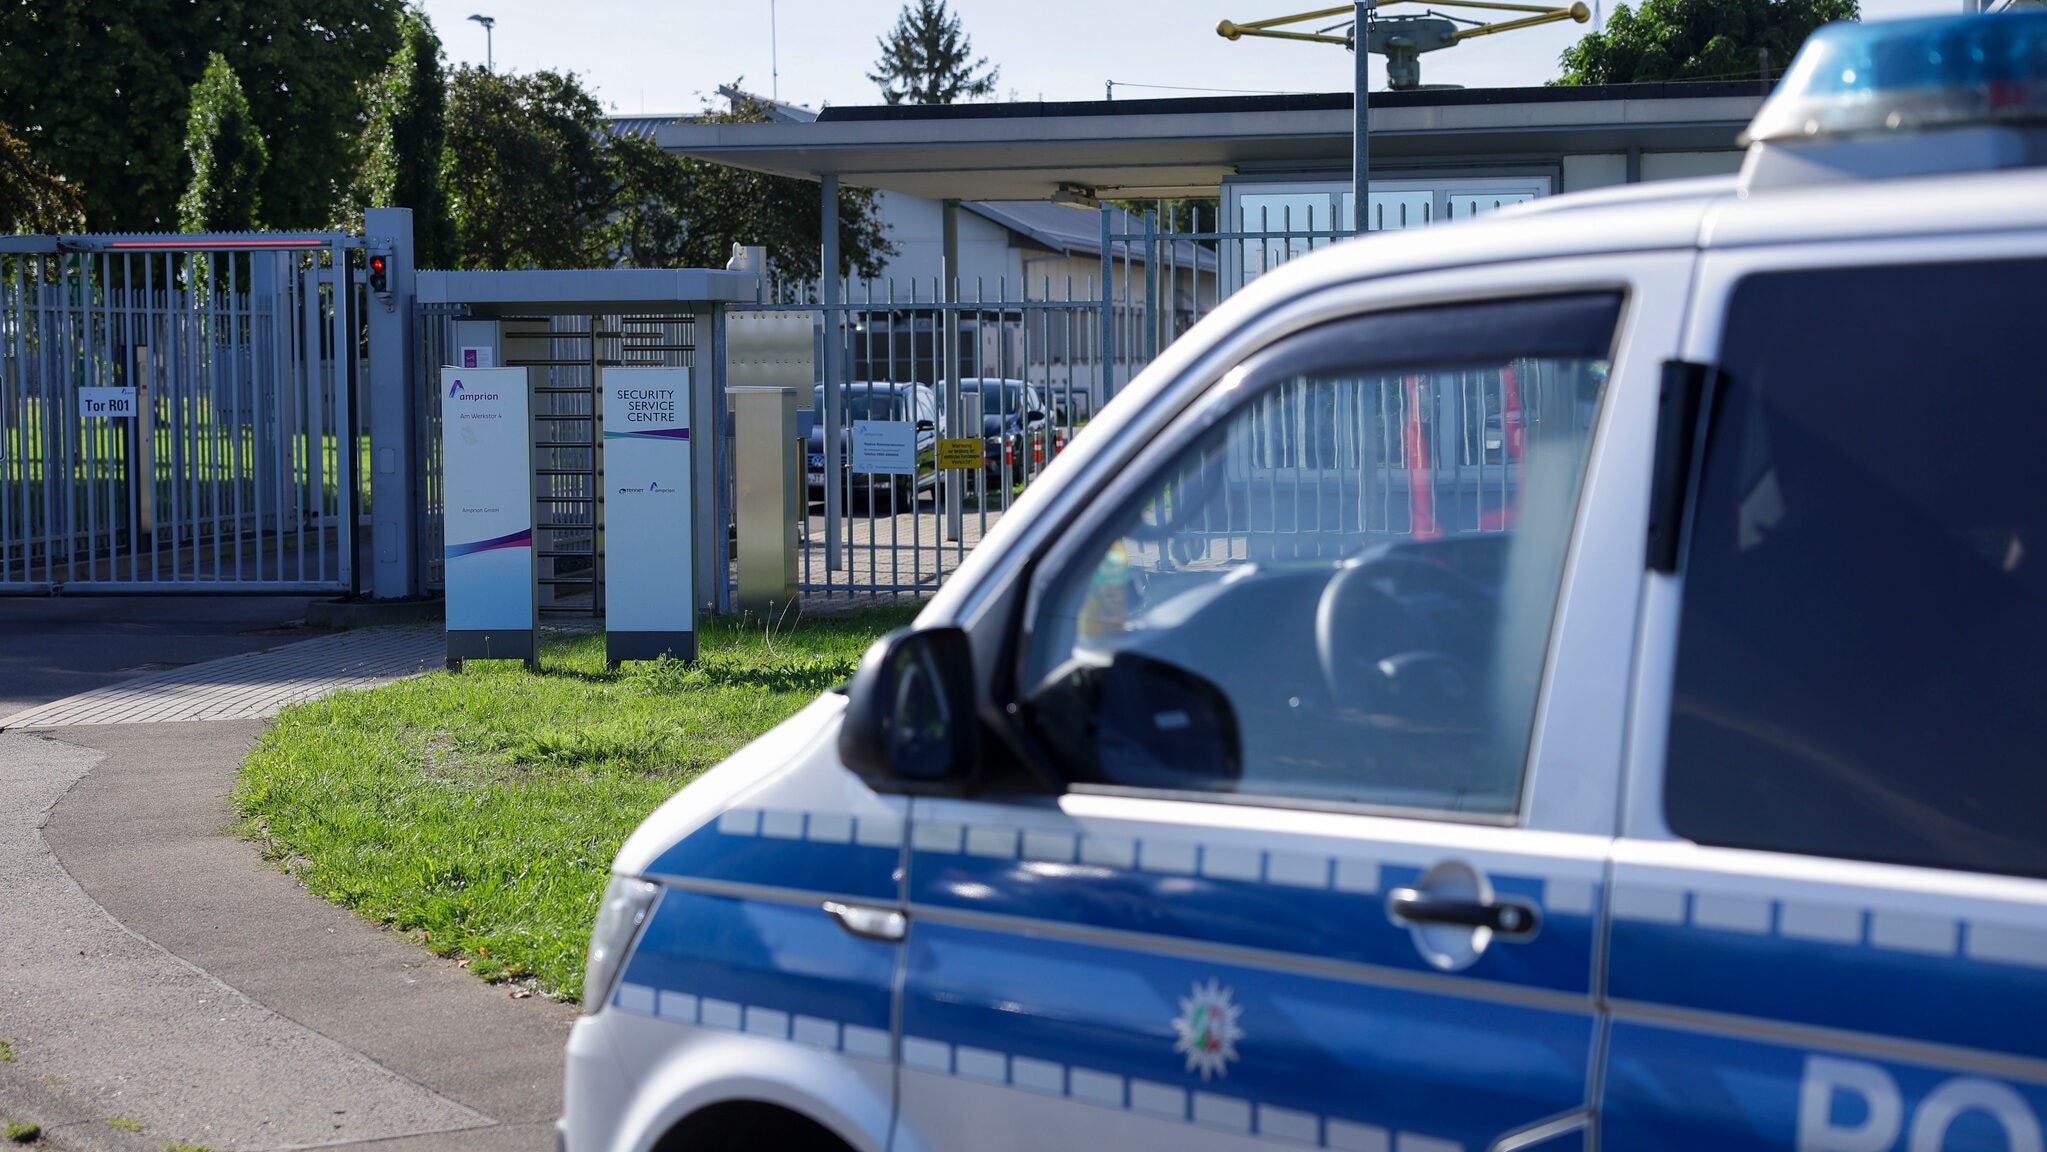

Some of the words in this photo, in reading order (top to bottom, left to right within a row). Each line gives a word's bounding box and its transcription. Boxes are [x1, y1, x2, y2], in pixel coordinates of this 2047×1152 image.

[460, 393, 499, 402] amprion
[617, 389, 674, 400] SECURITY
[85, 399, 106, 412] Tor
[109, 399, 129, 412] R01
[628, 401, 675, 411] SERVICE
[627, 412, 675, 422] CENTRE
